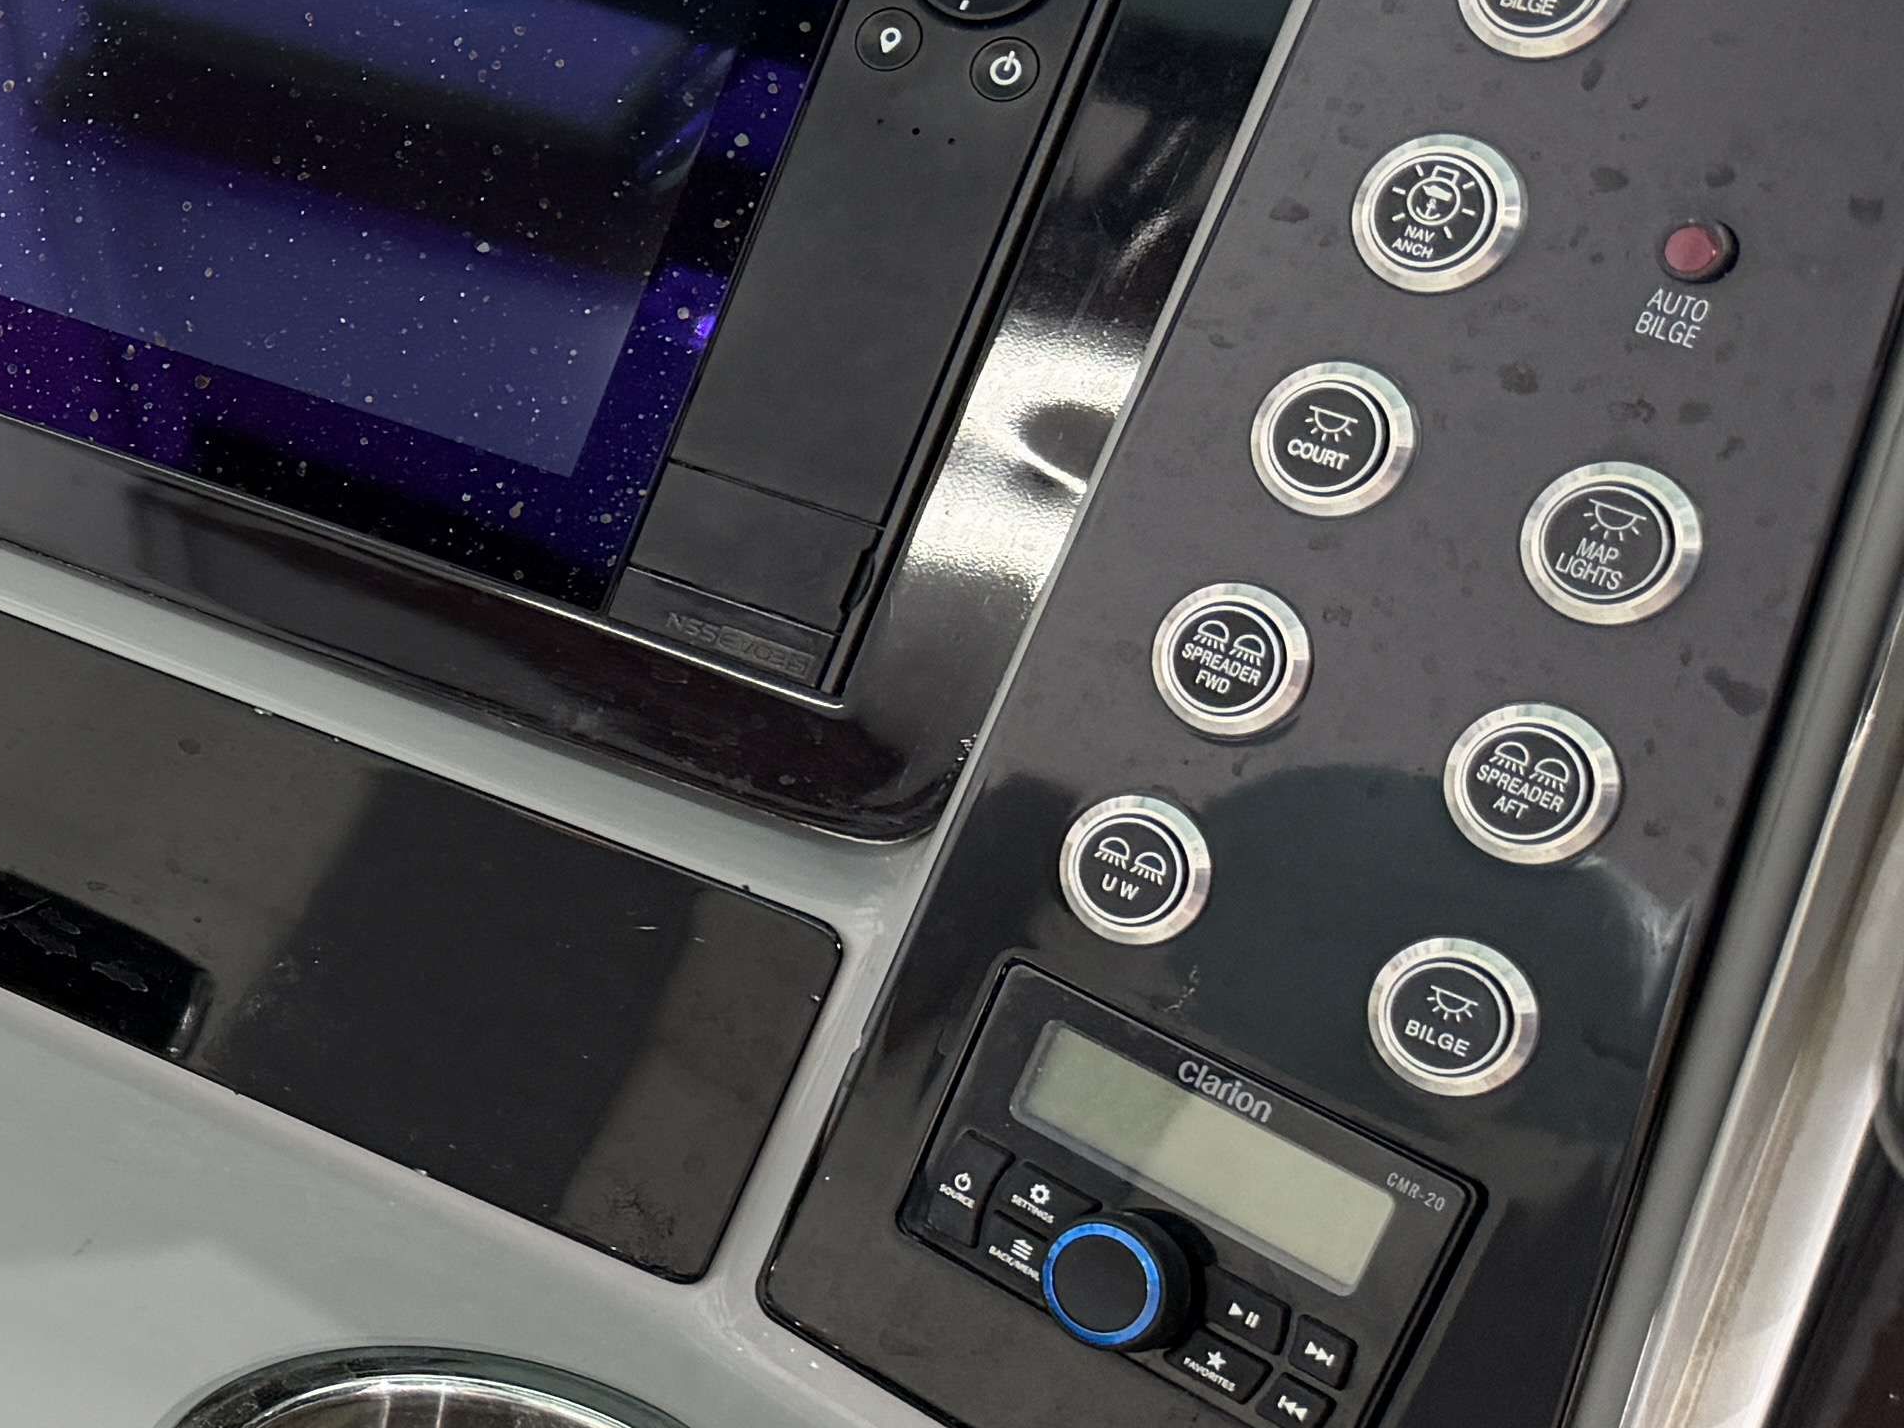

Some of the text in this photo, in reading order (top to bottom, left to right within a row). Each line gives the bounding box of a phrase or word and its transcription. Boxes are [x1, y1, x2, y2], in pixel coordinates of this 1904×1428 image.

[1391, 237, 1435, 259] ANCH
[1404, 224, 1436, 243] NAV
[1646, 287, 1710, 322] AUTO
[1634, 310, 1702, 349] BILGE
[1287, 438, 1350, 471] COURT
[1575, 537, 1620, 565] MAP
[1555, 552, 1623, 591] LIGHTS
[1181, 642, 1262, 687] SPREADER
[1195, 669, 1232, 695] FWD
[1476, 764, 1565, 813] SPREADER
[1492, 795, 1529, 819] AFT
[1404, 1019, 1471, 1058] BILGE
[1178, 1060, 1273, 1124] Clarion
[939, 1183, 976, 1209] SOURCE
[1011, 1194, 1055, 1224] SETTINGS
[1385, 1171, 1446, 1213] CMR-20
[1183, 1356, 1236, 1392] FAVORITES
